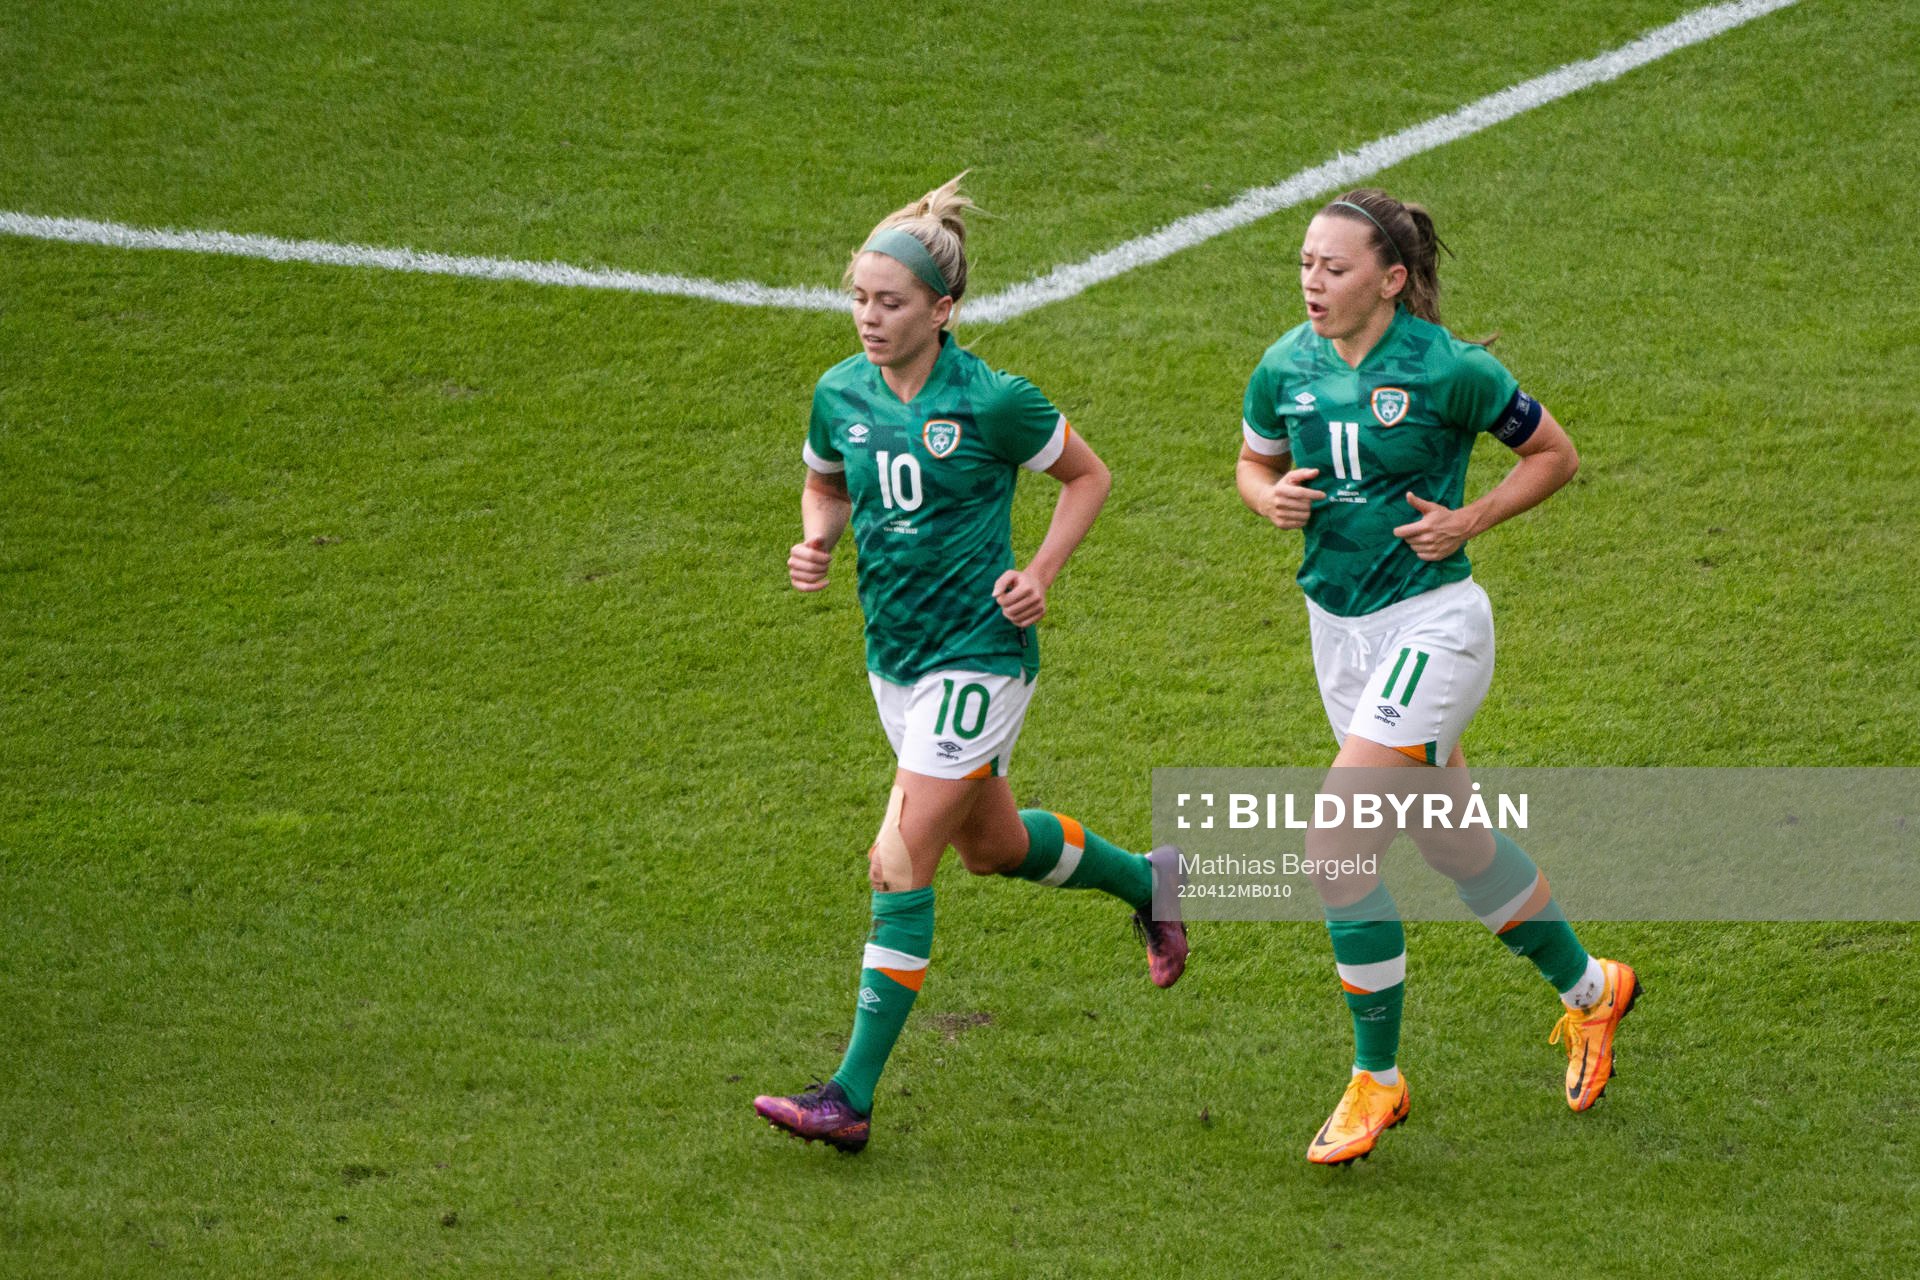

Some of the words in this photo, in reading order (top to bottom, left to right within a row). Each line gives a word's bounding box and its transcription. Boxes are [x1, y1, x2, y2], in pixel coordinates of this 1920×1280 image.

[876, 450, 923, 511] 10
[1328, 421, 1362, 481] 11
[1380, 647, 1430, 708] 11
[933, 678, 991, 740] 10
[1374, 714, 1396, 727] umbro
